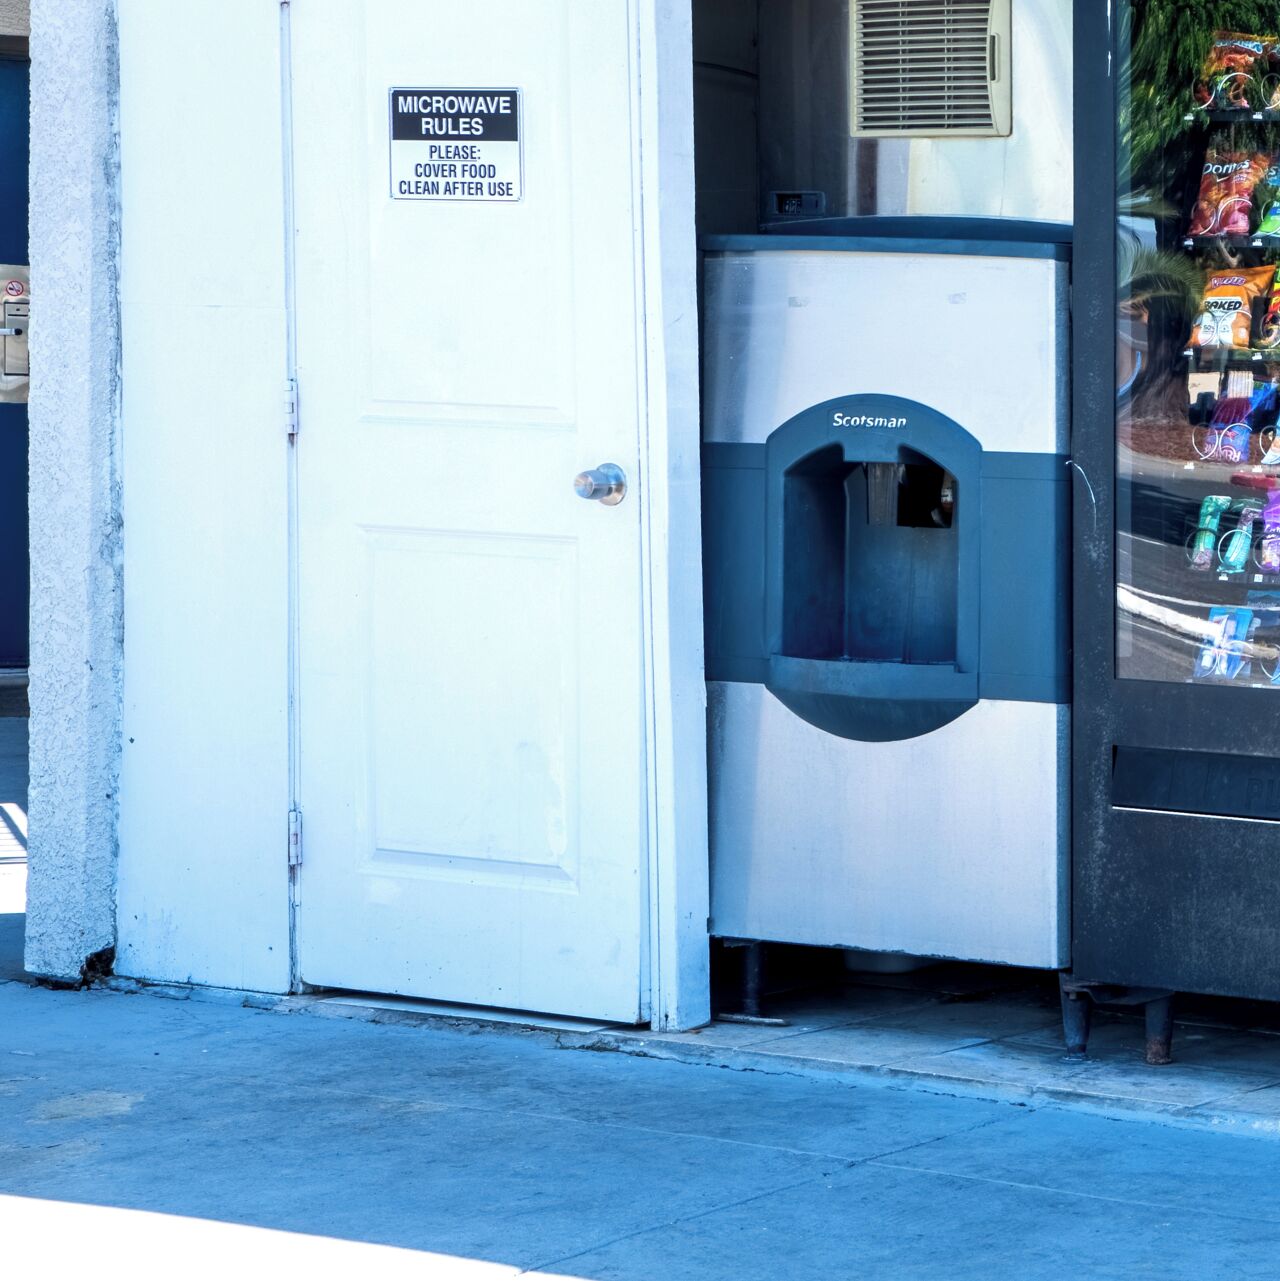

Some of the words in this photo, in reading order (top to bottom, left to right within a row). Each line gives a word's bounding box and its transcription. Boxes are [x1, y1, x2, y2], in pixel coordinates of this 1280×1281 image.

[398, 96, 511, 114] MICROWAVE
[421, 118, 484, 135] RULES
[429, 145, 481, 160] PLEASE:
[415, 163, 457, 178] COVER
[461, 164, 496, 178] FOOD
[1203, 160, 1250, 174] Doritos
[399, 180, 439, 195] CLEAN
[443, 181, 484, 195] AFTER
[488, 182, 513, 196] USE
[832, 412, 907, 428] Scotsman
